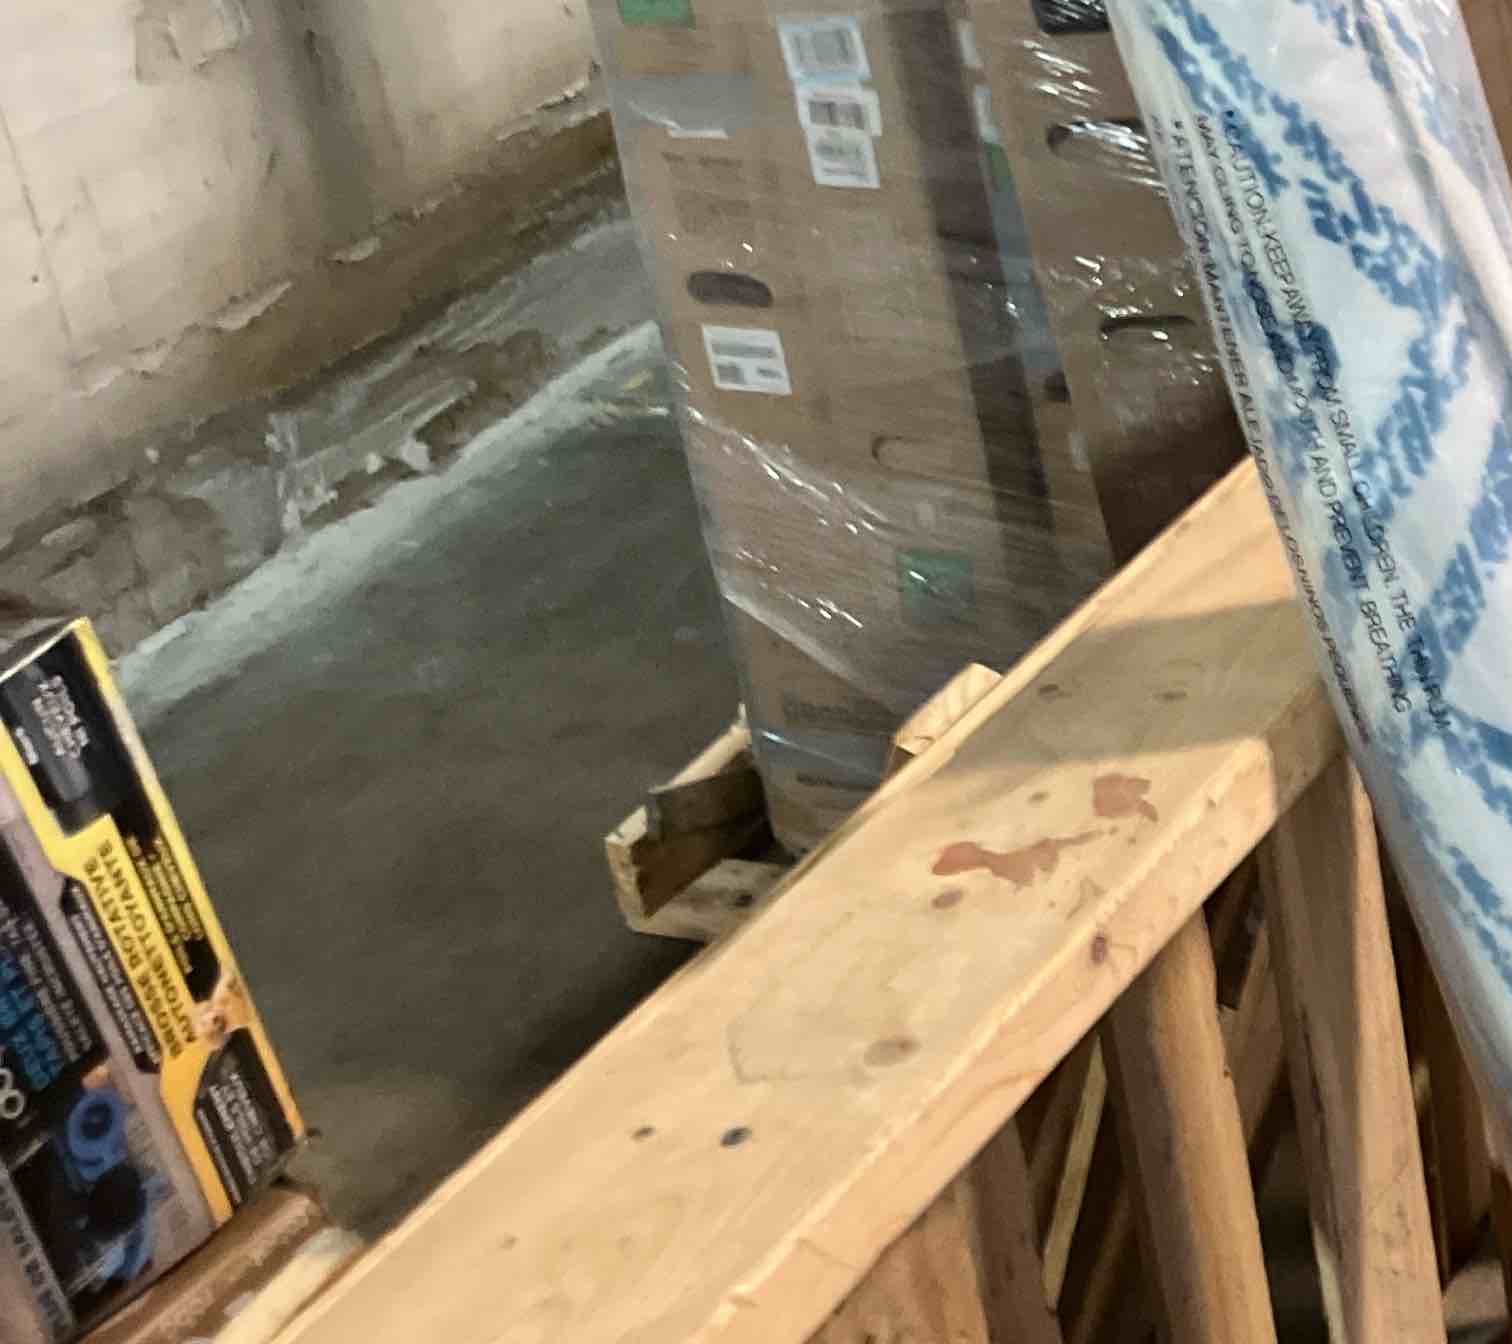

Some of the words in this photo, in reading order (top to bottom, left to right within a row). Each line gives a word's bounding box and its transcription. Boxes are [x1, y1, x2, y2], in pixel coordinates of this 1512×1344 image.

[1192, 110, 1222, 162] MAY
[1211, 163, 1247, 236] CLING
[1234, 239, 1256, 268] TO
[1260, 230, 1295, 286] KEEP
[1327, 408, 1363, 476] SMALL
[1387, 587, 1418, 632] THE
[1309, 453, 1339, 500] AND
[1323, 499, 1370, 594] PREVENT
[1358, 598, 1413, 715] BREATHING
[79, 856, 144, 971] ROTATIVE
[94, 837, 198, 1045] AUTONETTOYANTE
[134, 971, 184, 1059] BROSSE
